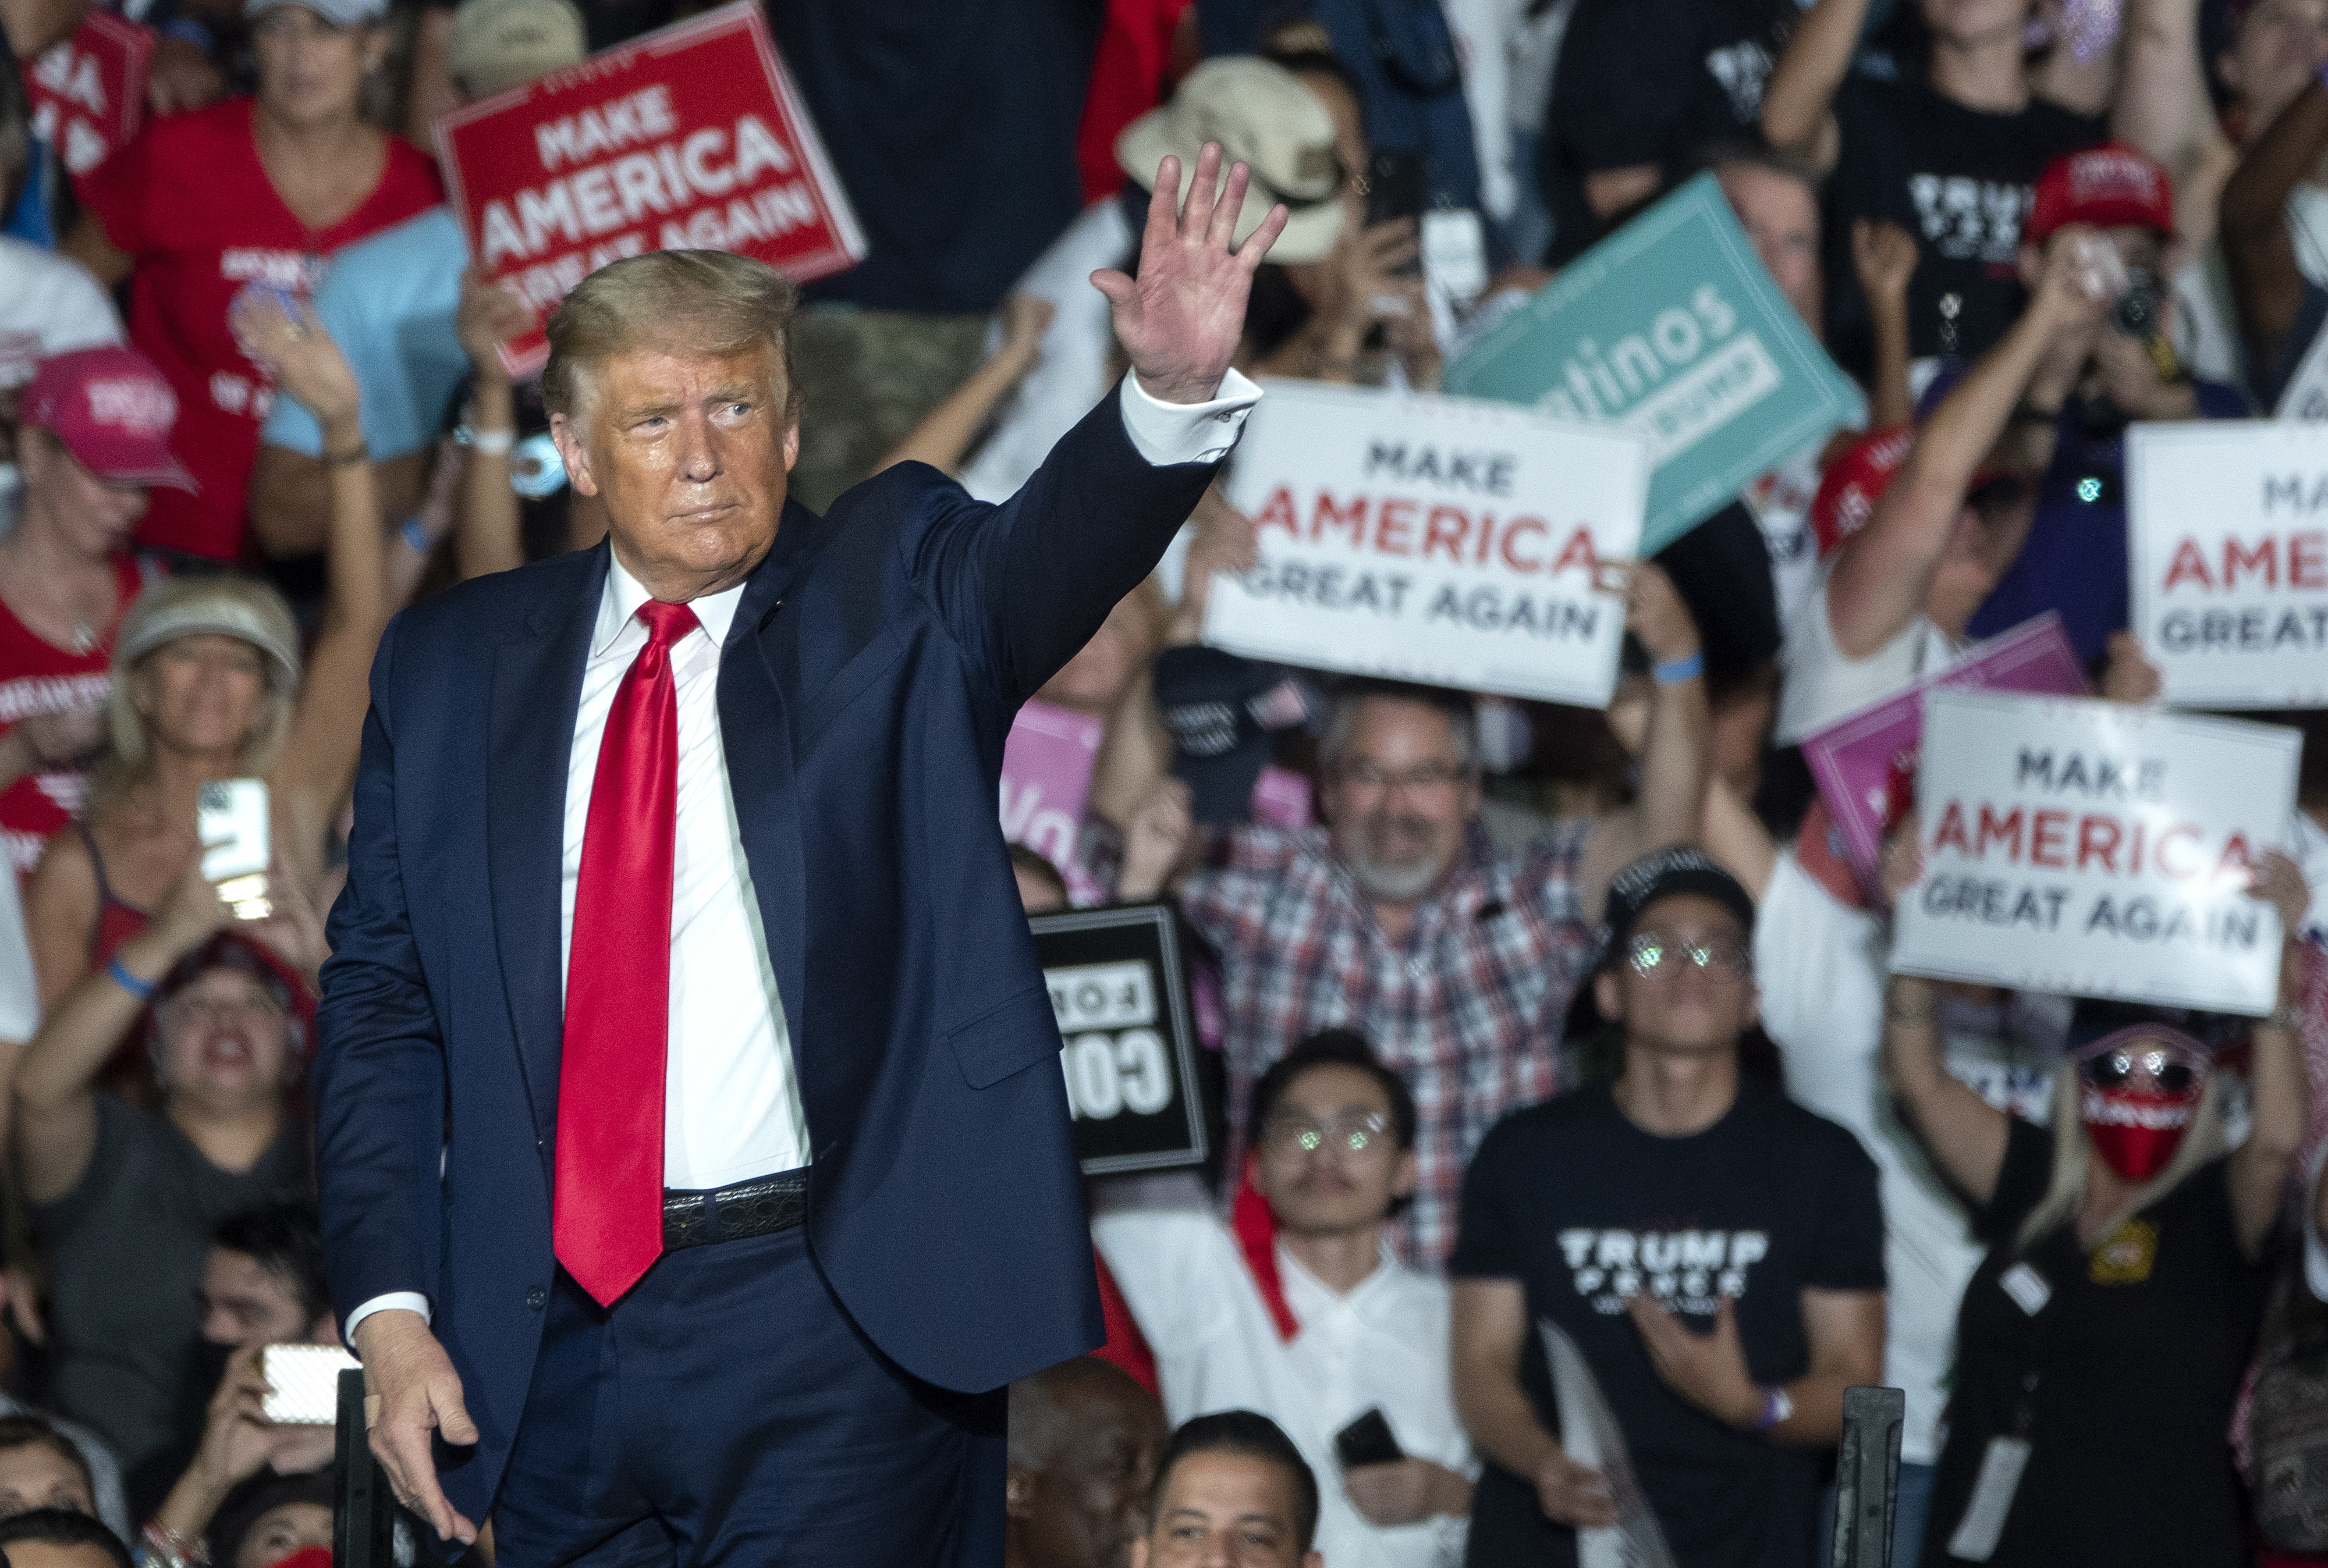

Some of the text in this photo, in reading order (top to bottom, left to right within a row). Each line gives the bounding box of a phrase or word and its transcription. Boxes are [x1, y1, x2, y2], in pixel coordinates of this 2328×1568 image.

[535, 84, 676, 170] MAKE
[482, 116, 793, 265] AMERICA
[659, 181, 814, 250] AGAIN
[1365, 438, 1517, 497] MAKE
[1254, 483, 1600, 589] AMERICA
[1240, 560, 1598, 643] GREAT AGAIN
[2160, 606, 2328, 654] GREAT
[2016, 747, 2167, 798] MAKE
[1935, 797, 2255, 883] AMERICA
[1921, 873, 2261, 951] GREAT AGAIN
[1557, 1228, 1769, 1271] TRUMP
